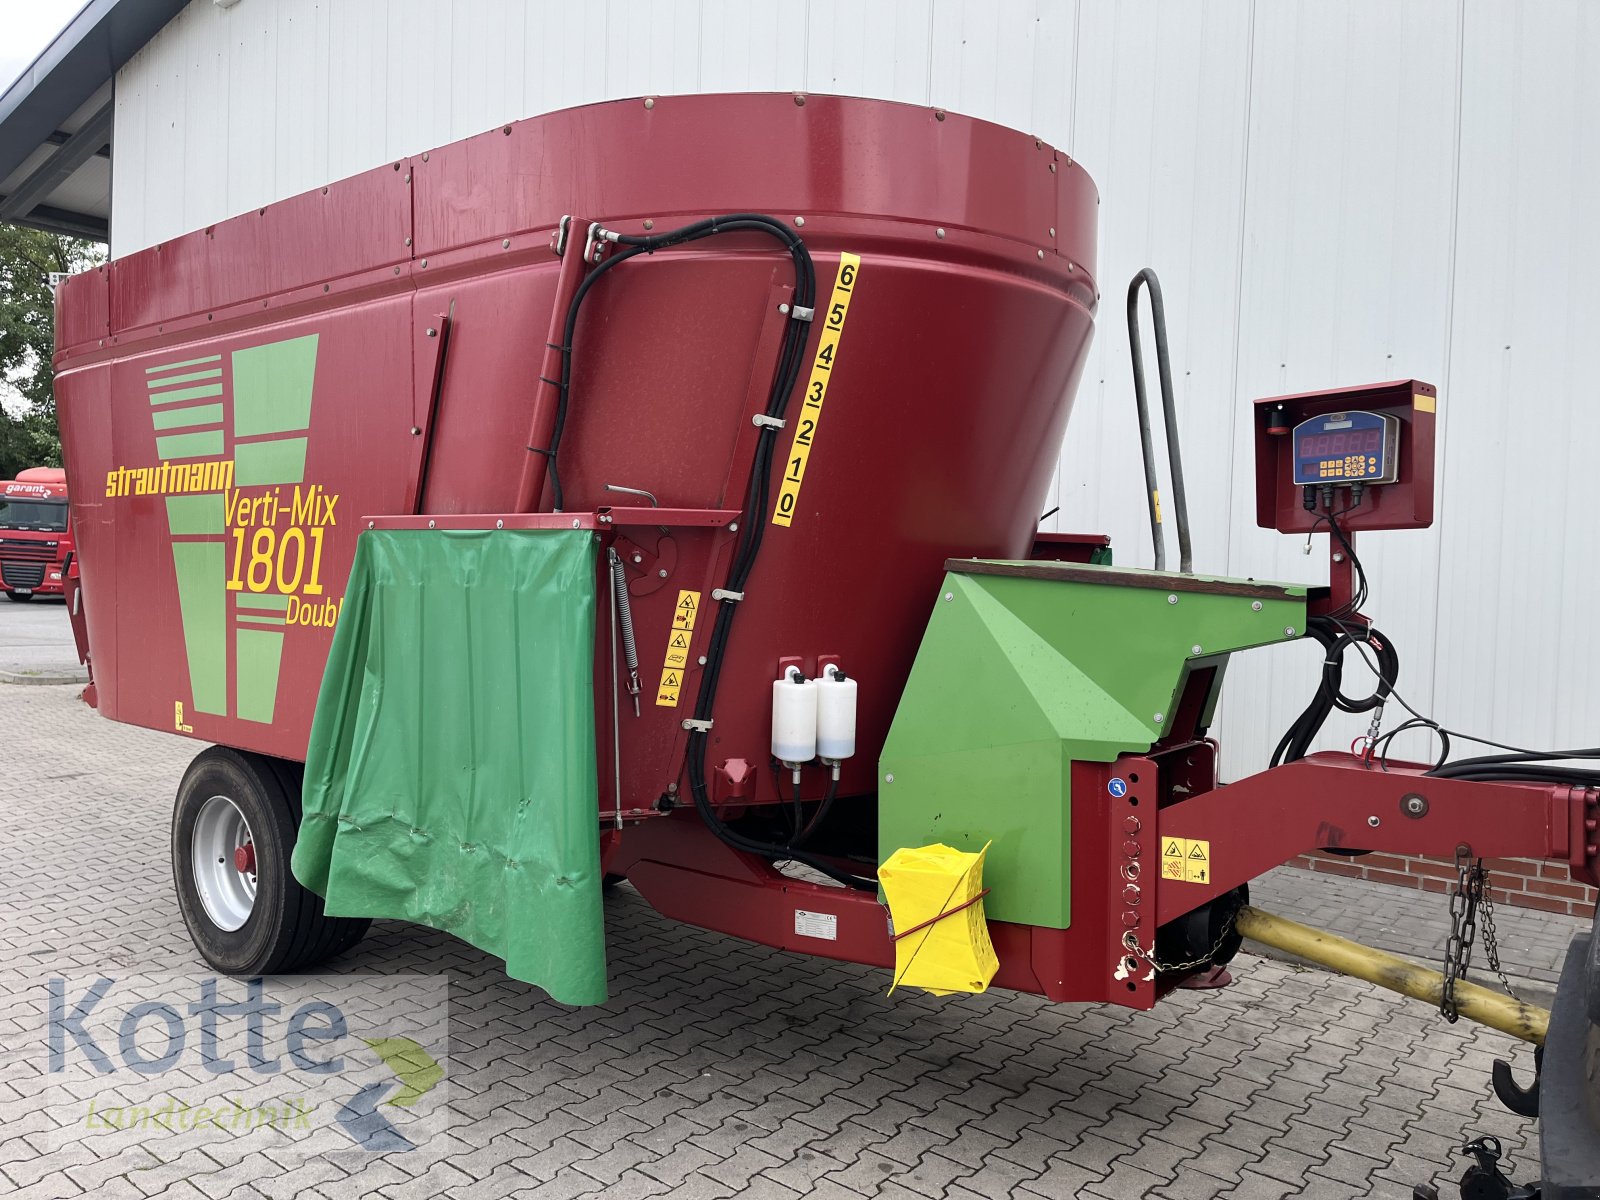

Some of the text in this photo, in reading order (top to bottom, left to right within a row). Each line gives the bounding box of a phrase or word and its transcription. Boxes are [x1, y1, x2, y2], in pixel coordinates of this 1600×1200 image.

[840, 264, 855, 286] 6
[829, 303, 845, 325] 5
[819, 343, 833, 365] 4
[809, 381, 823, 403] 3
[798, 419, 814, 441] 2
[105, 460, 234, 497] strautmann
[791, 457, 802, 478] 1
[5, 484, 45, 494] garant
[224, 485, 339, 527] Verti-Mix
[780, 493, 794, 513] 0
[226, 527, 324, 595] 1801
